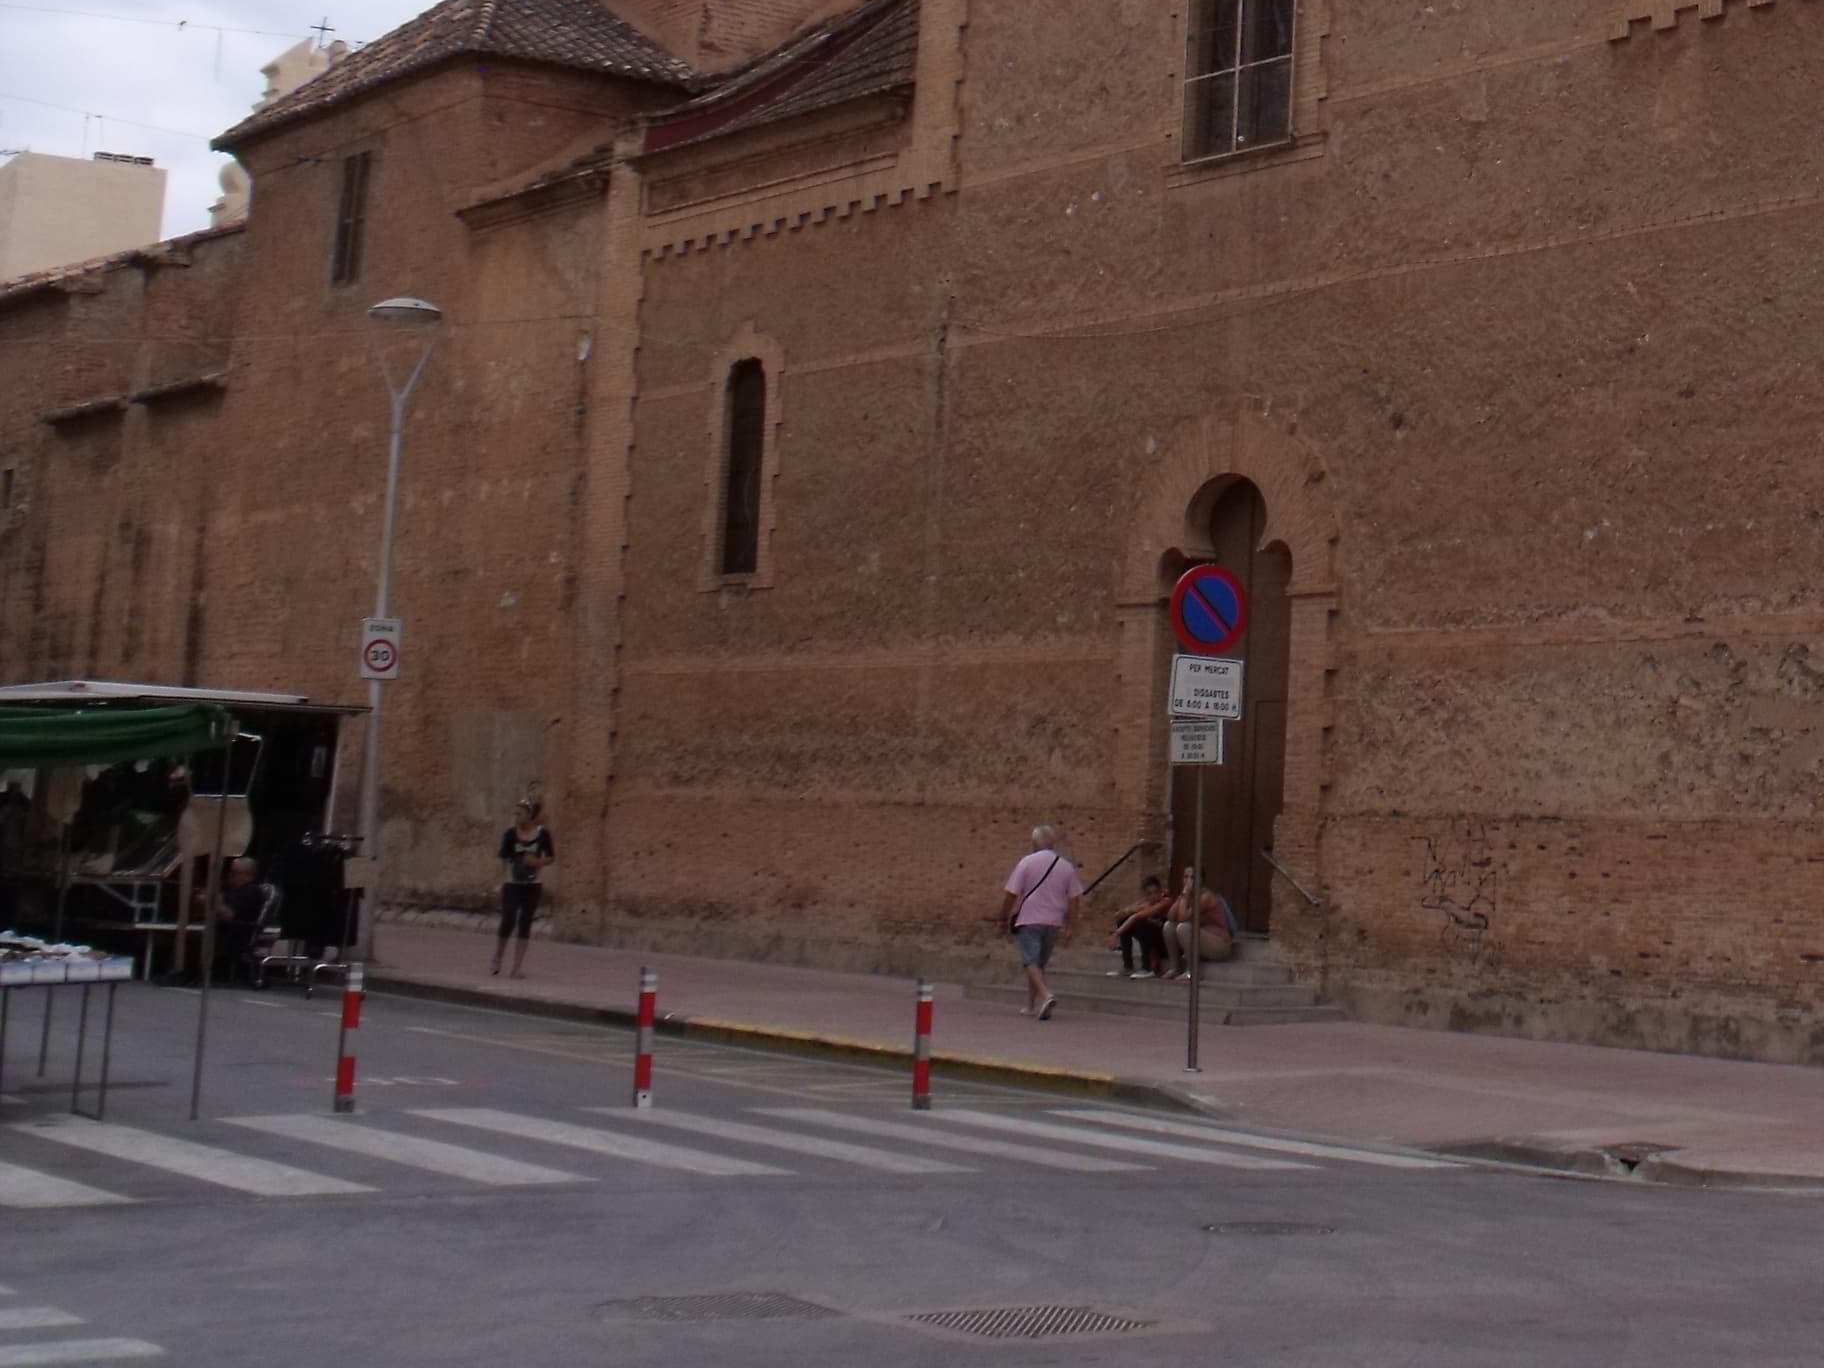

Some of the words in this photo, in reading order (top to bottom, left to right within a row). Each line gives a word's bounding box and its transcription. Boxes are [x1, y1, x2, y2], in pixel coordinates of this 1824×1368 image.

[371, 650, 390, 661] 30
[1189, 663, 1202, 673] PER
[1205, 665, 1229, 675] MERCAT
[1174, 698, 1183, 708] DE
